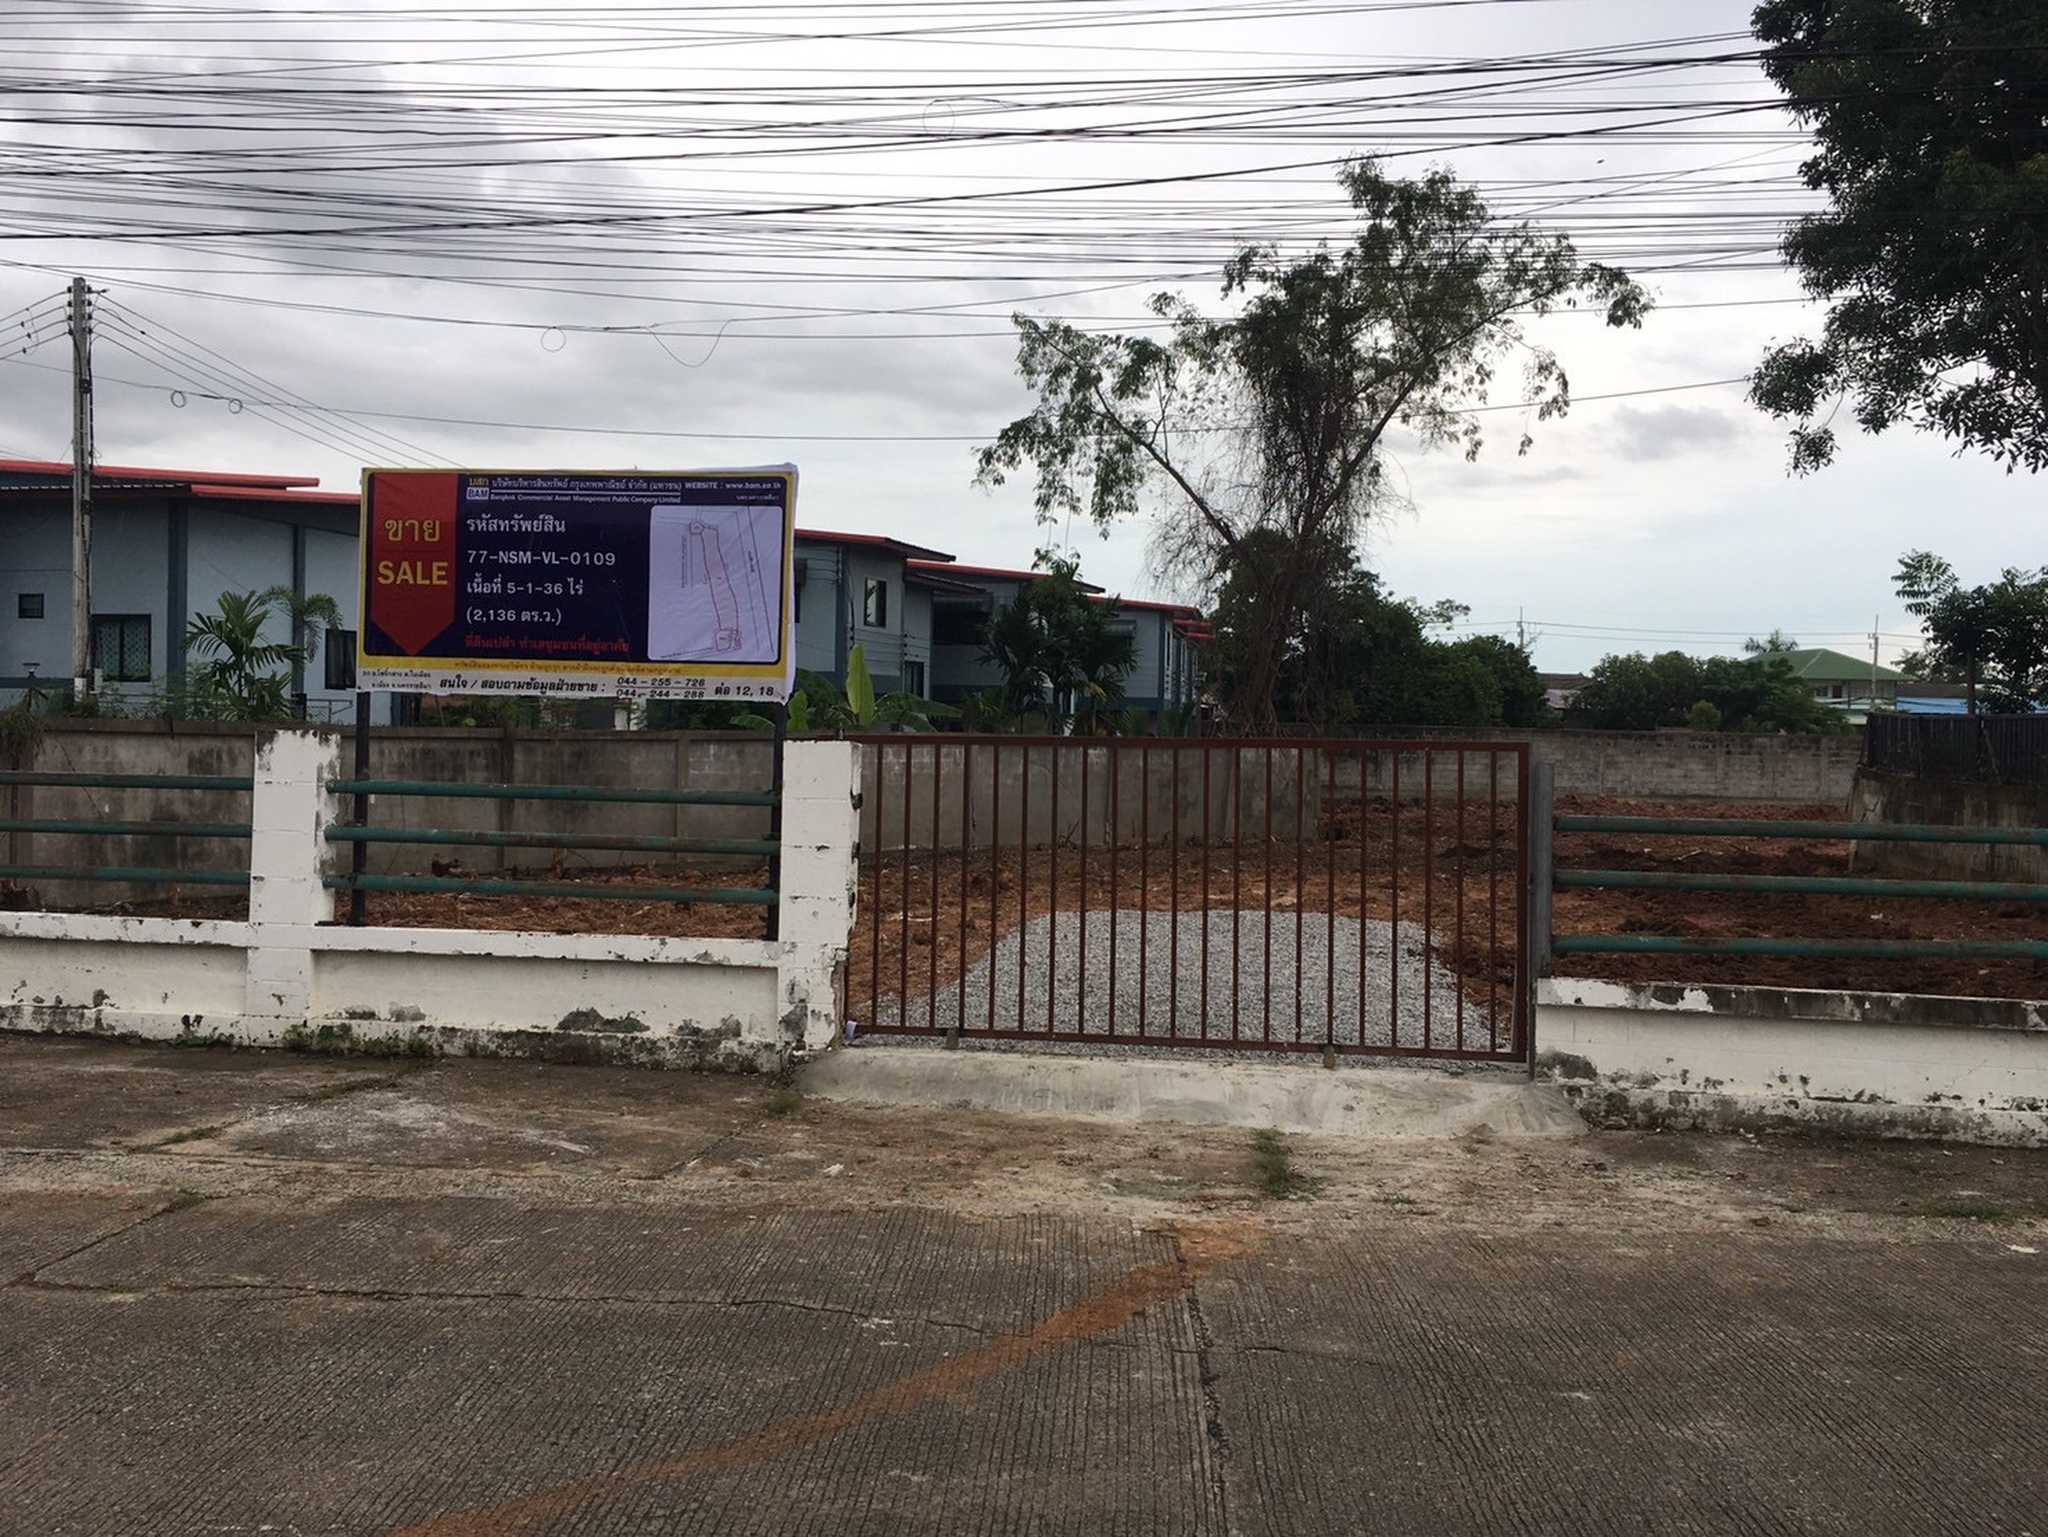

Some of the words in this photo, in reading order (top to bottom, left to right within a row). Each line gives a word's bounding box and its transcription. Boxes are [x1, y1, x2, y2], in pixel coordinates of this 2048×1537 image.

[468, 488, 489, 498] BAM
[573, 495, 611, 503] Management
[631, 496, 658, 504] Company
[385, 519, 440, 542] ขาย
[466, 513, 567, 533] รหัสทรัพย์สิน
[467, 550, 616, 566] 77-NSM-VL-0109
[377, 560, 449, 585] SALE
[466, 572, 502, 594] เนื้อที่
[507, 582, 563, 595] 5-1-36
[567, 577, 584, 595] ไร่
[466, 606, 516, 625] (2,136
[440, 673, 469, 689] สนใจ
[481, 677, 599, 694] สอบถามข้อมูลฝ่ายขาย
[714, 681, 731, 696] ต่อ
[759, 686, 774, 696] 18
